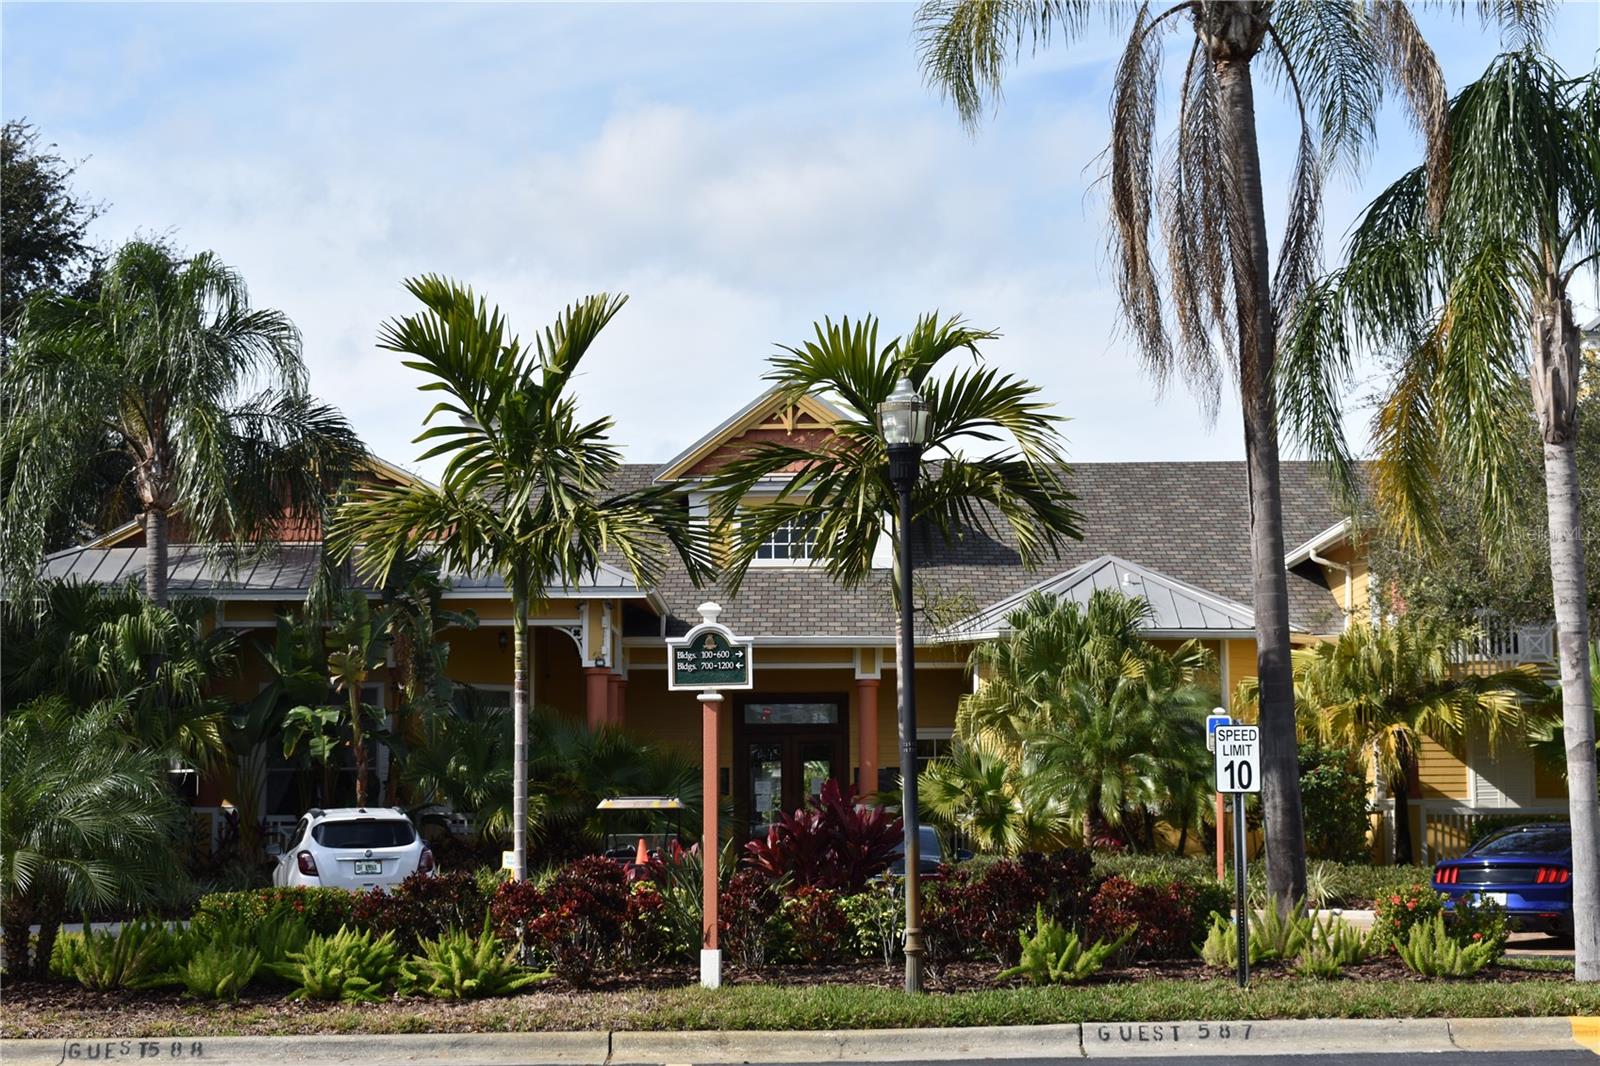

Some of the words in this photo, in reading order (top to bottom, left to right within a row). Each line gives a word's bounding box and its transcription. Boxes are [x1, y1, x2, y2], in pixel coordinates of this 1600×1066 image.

[1218, 729, 1257, 741] SPEED
[1222, 744, 1252, 756] LIMIT
[1224, 760, 1252, 789] 10
[1098, 1025, 1180, 1042] GUEST
[1198, 1024, 1252, 1040] 587
[68, 1040, 149, 1059] GUEST
